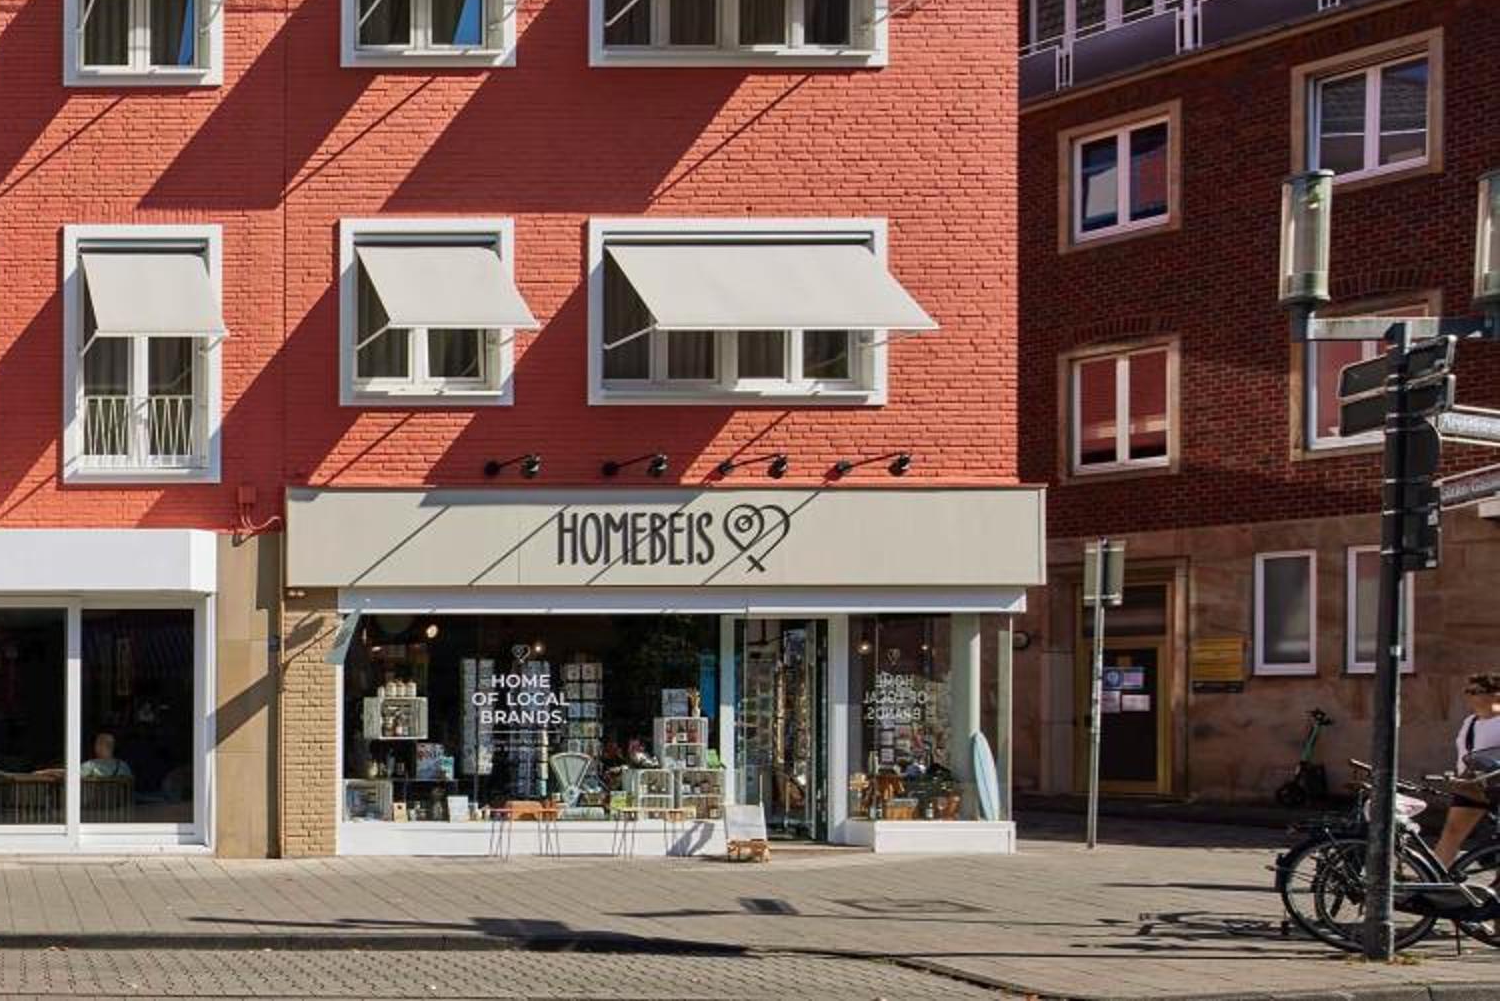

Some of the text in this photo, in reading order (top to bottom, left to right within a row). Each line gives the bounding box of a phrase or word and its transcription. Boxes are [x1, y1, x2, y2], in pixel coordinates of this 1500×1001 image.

[557, 511, 715, 566] HOMEBEIS
[491, 674, 551, 688] HOME
[471, 692, 570, 706] OF LOCAL
[480, 710, 567, 724] BRANDS.
